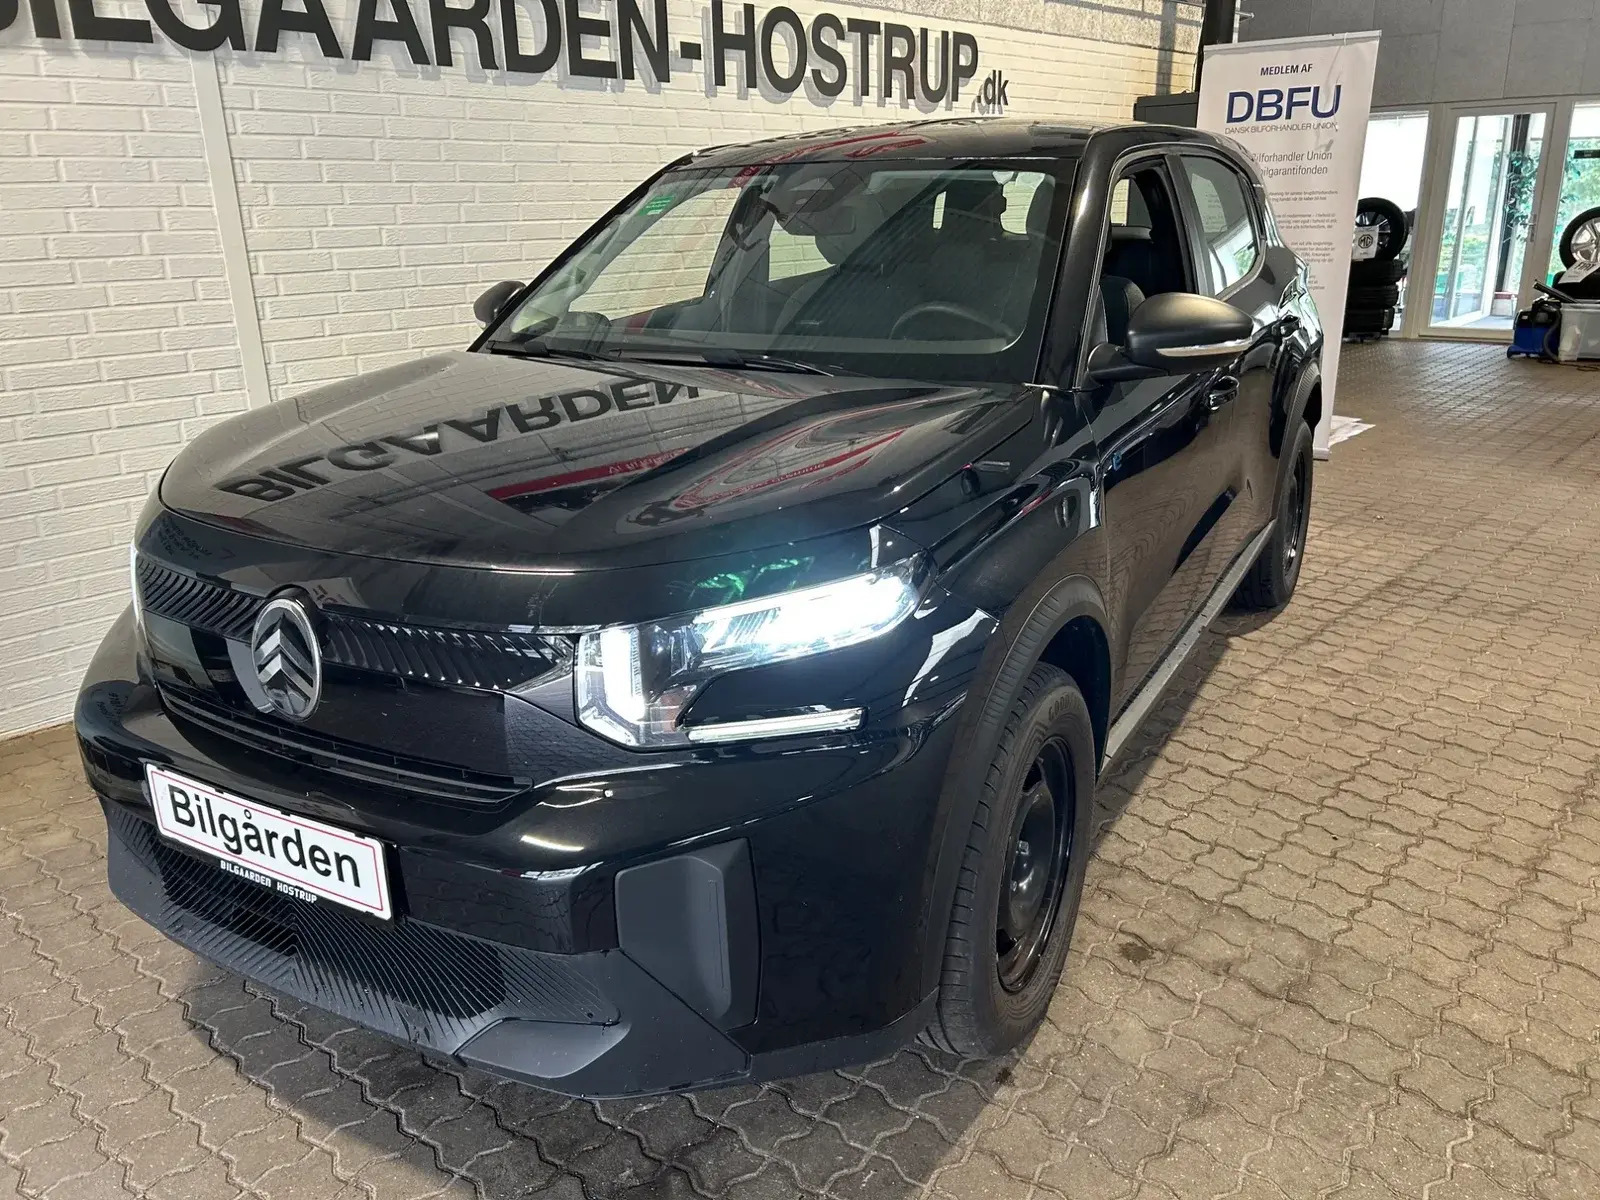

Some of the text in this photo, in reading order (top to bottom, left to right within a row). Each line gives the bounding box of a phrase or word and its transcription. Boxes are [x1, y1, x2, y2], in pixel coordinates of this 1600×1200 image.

[1260, 63, 1313, 76] MEDLEM AF
[1226, 84, 1342, 124] DBFU
[1225, 122, 1337, 135] DANSK BILFORHANDLER UNION
[1306, 150, 1333, 161] Union
[167, 783, 362, 889] Bilgården
[220, 859, 317, 904] BILGAARDEN HOSTRUP
